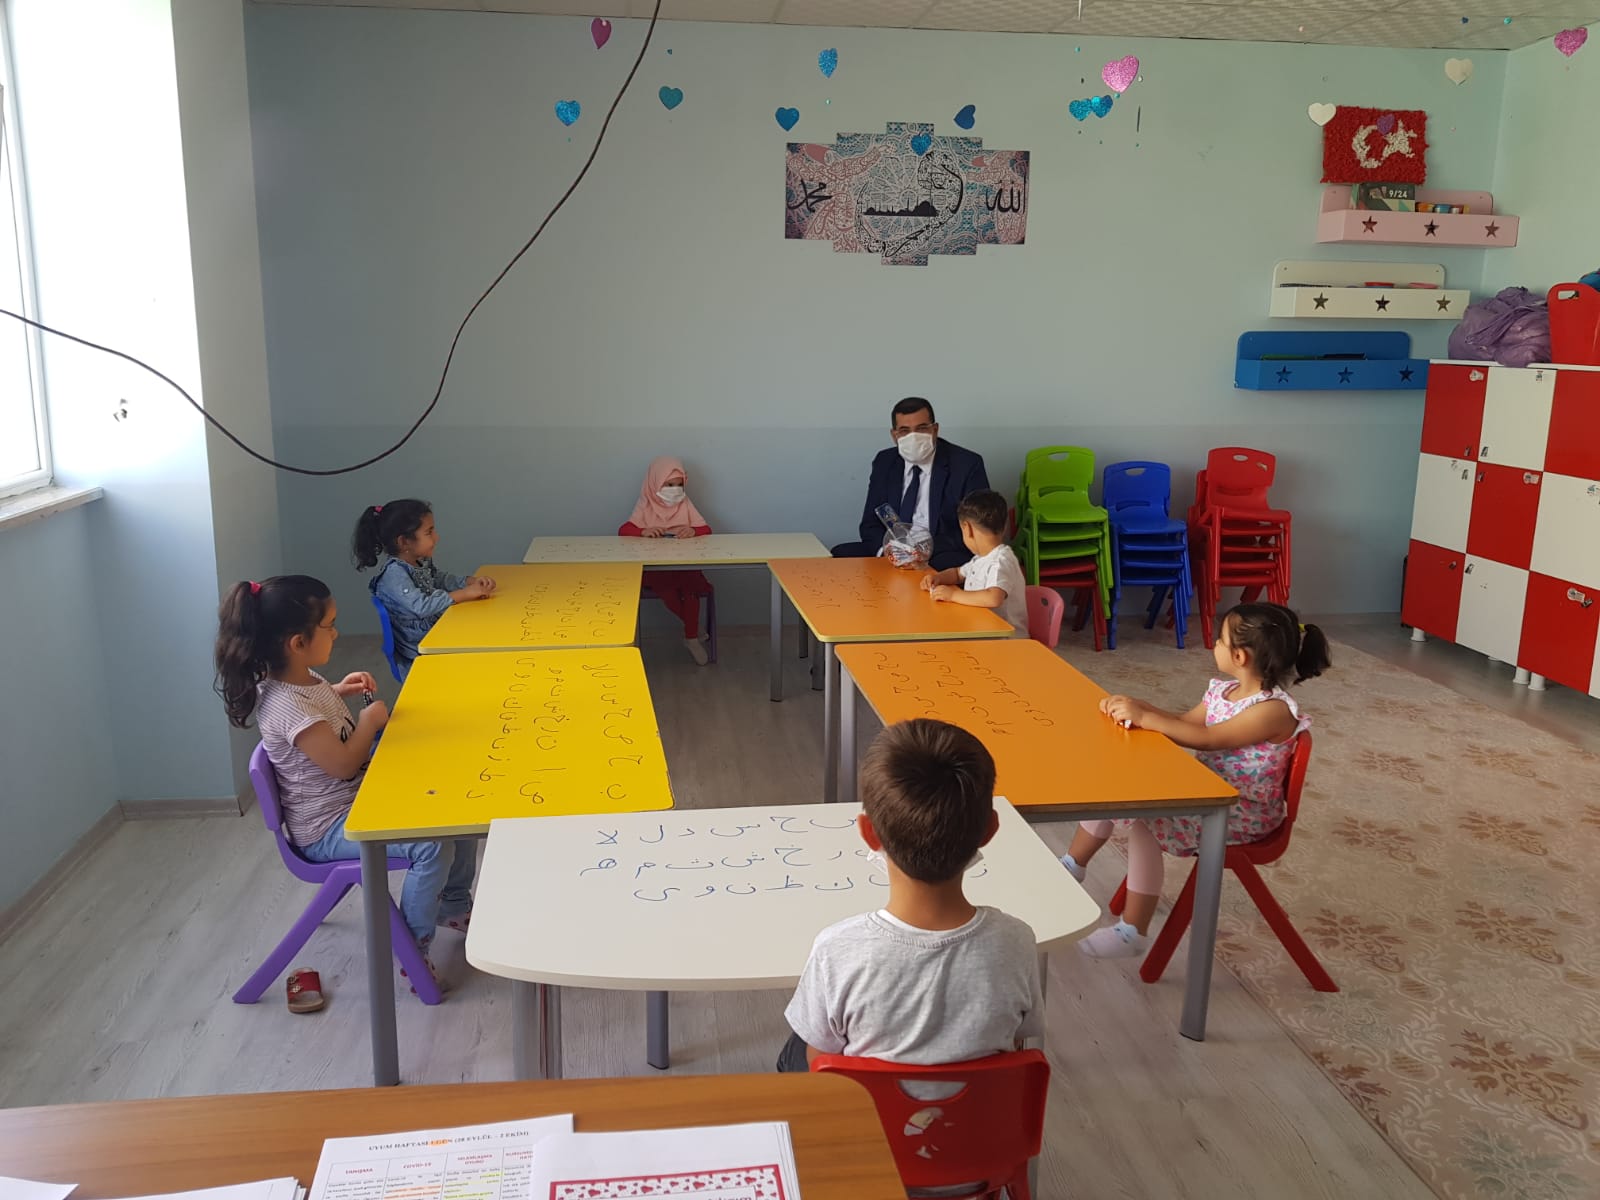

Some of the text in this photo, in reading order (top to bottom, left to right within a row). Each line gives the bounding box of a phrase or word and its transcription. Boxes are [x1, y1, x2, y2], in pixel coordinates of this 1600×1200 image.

[1388, 189, 1408, 198] 9/24
[596, 829, 618, 844] لا
[640, 825, 664, 843] ل
[710, 823, 760, 837] س
[721, 851, 765, 868] ش
[635, 862, 656, 879] م
[694, 885, 716, 898] و
